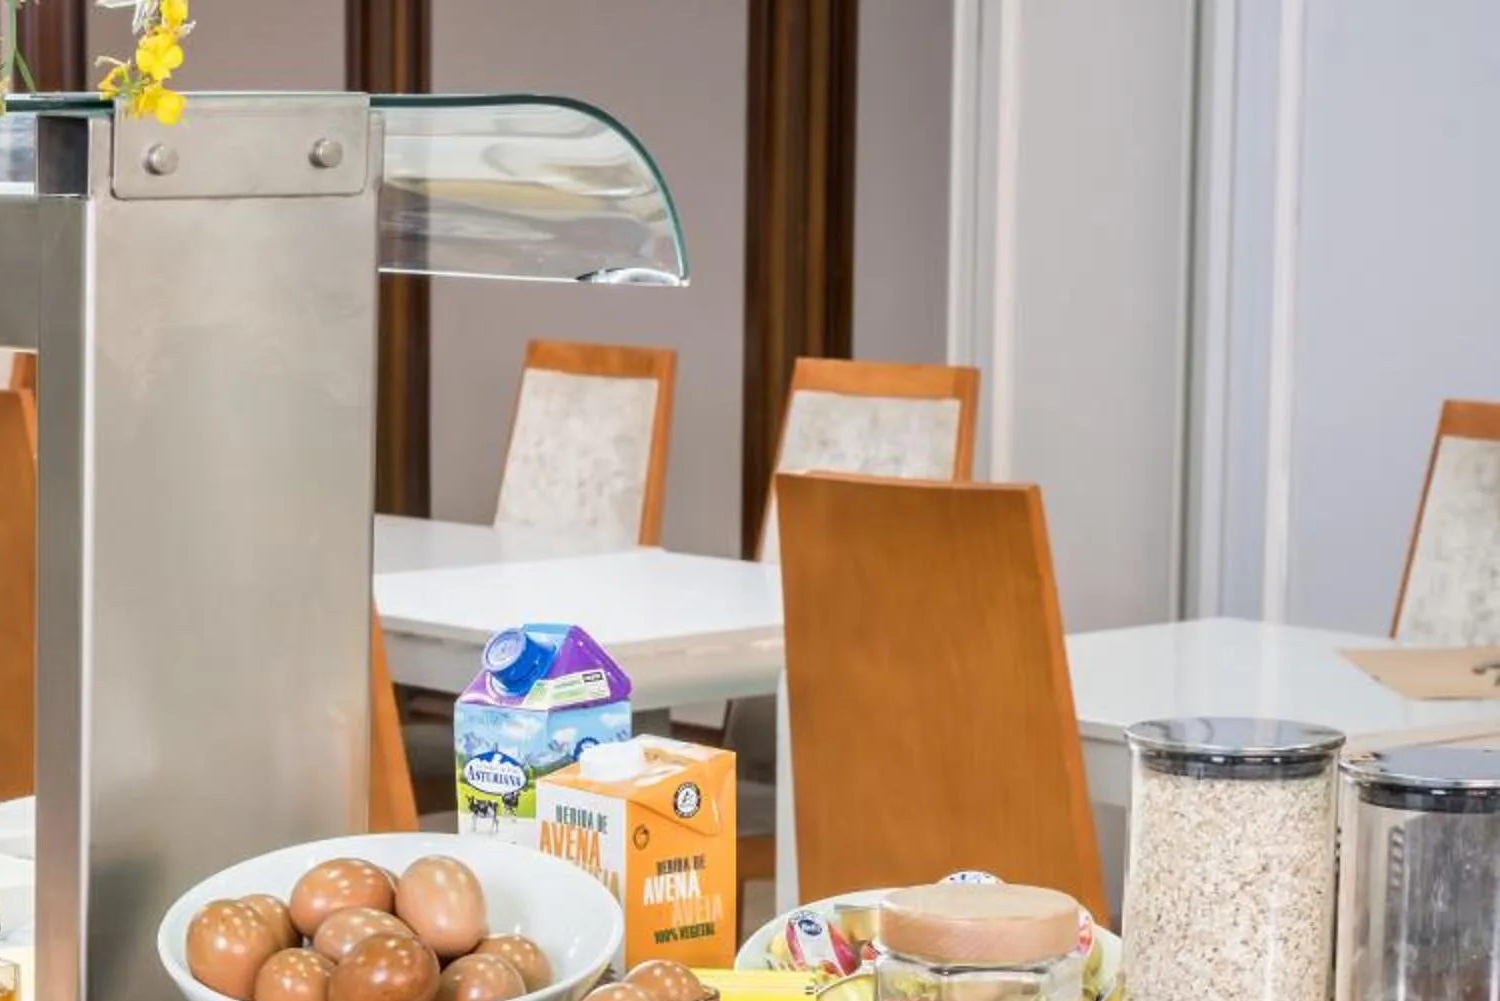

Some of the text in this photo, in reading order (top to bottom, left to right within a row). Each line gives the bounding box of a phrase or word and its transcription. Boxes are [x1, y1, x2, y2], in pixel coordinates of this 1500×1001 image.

[538, 819, 603, 869] AVENA
[693, 853, 706, 869] DE
[643, 870, 701, 906] AVENA
